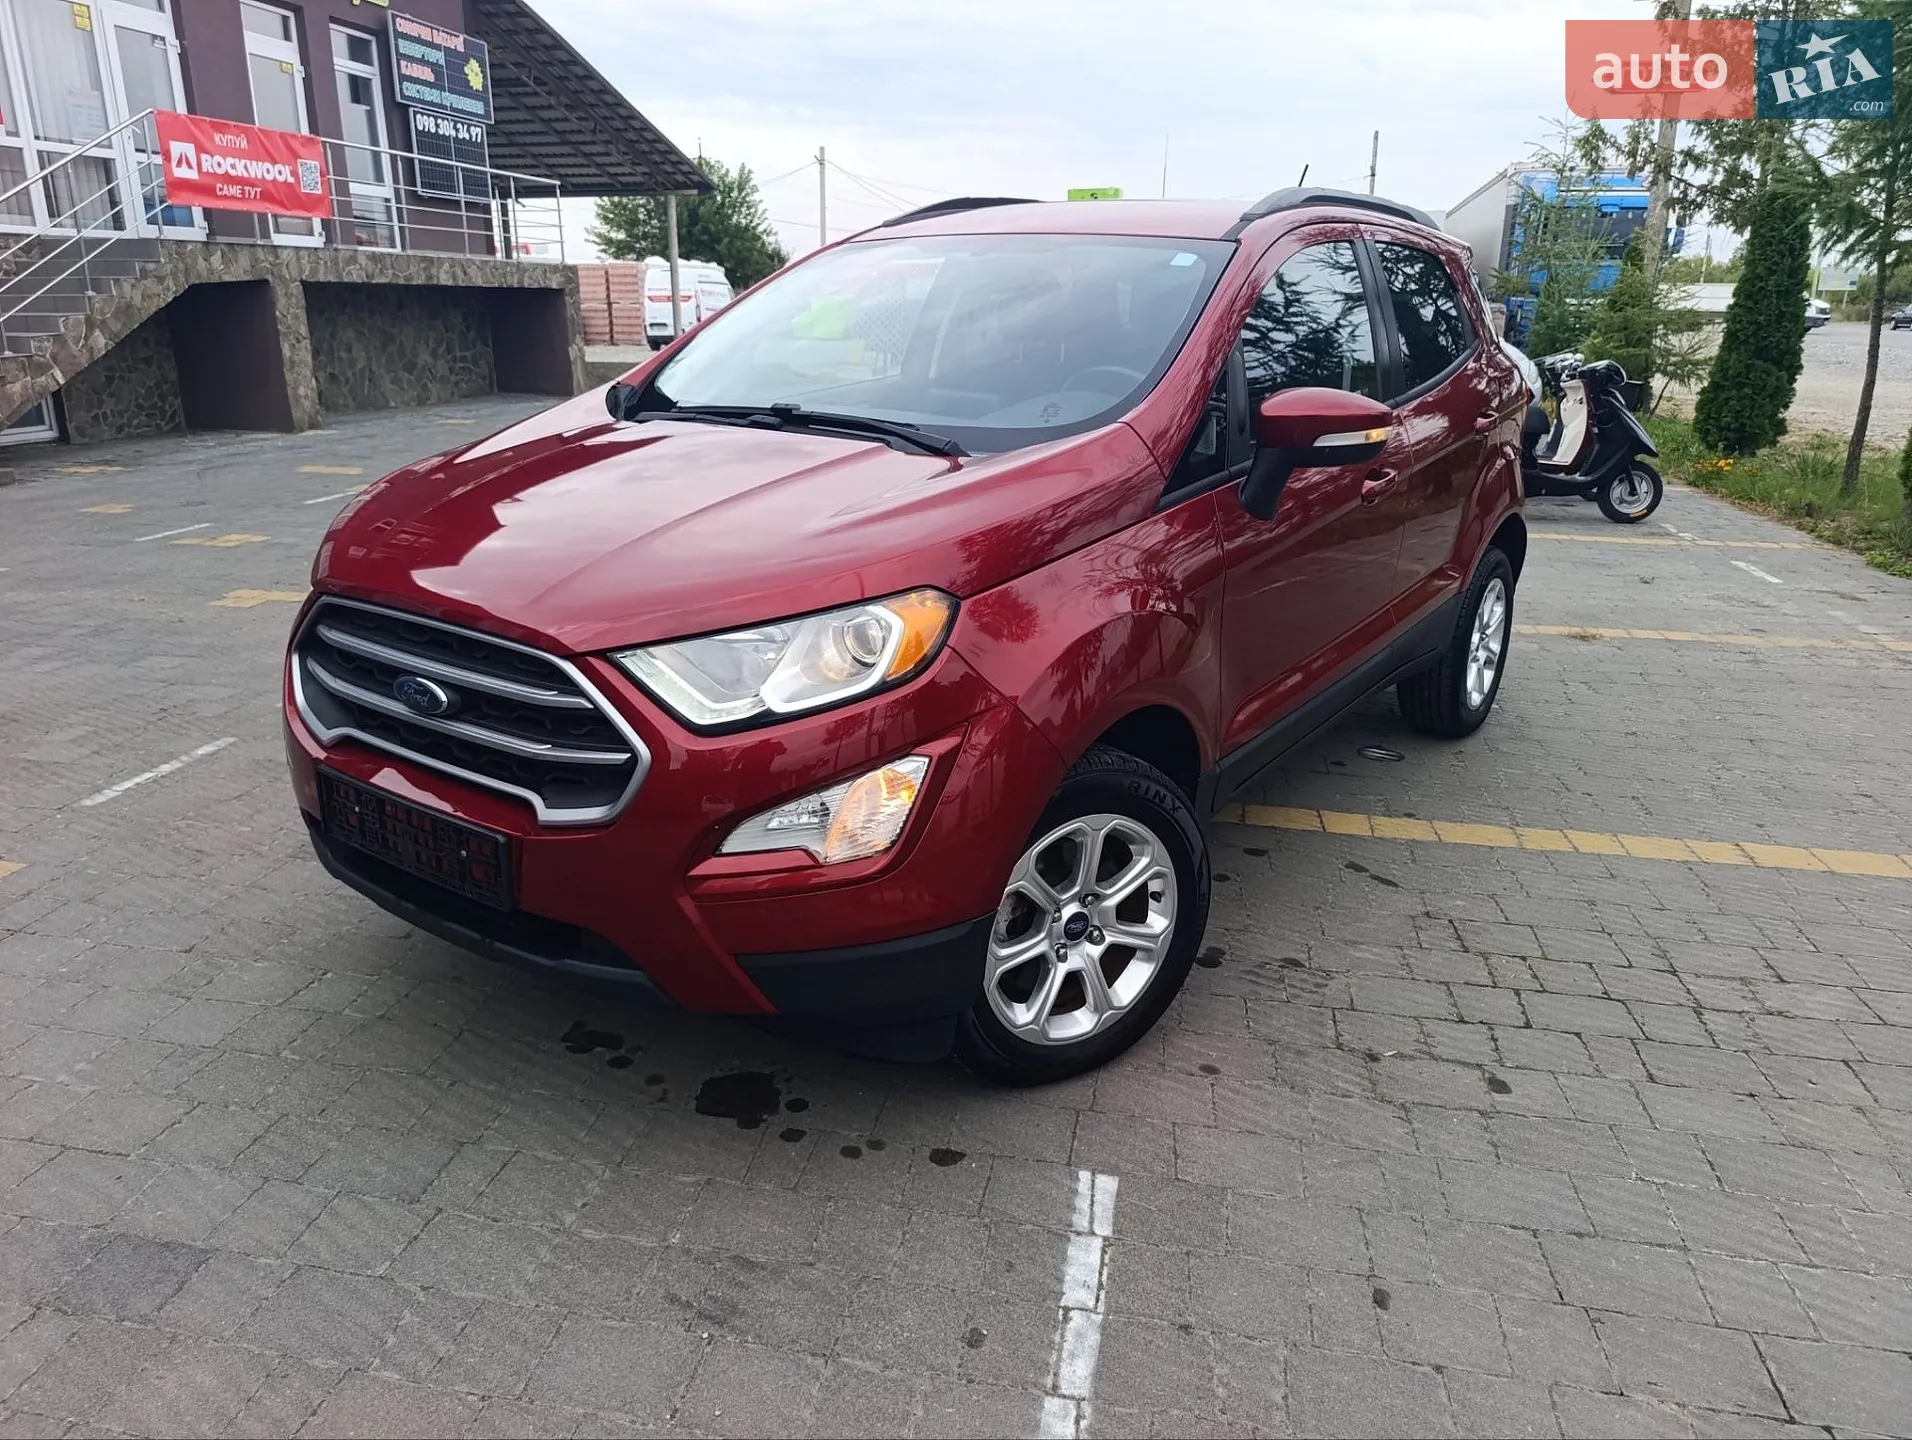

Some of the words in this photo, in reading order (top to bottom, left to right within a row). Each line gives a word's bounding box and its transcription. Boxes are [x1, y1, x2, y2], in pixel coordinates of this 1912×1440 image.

[416, 113, 436, 133] 098
[437, 118, 456, 138] 304
[456, 123, 470, 140] 34
[469, 125, 482, 143] 97
[214, 132, 248, 150] КУПУЙ
[200, 153, 295, 183] ROCKWOOL
[216, 183, 243, 198] САМЕ
[244, 187, 262, 200] ТУТ
